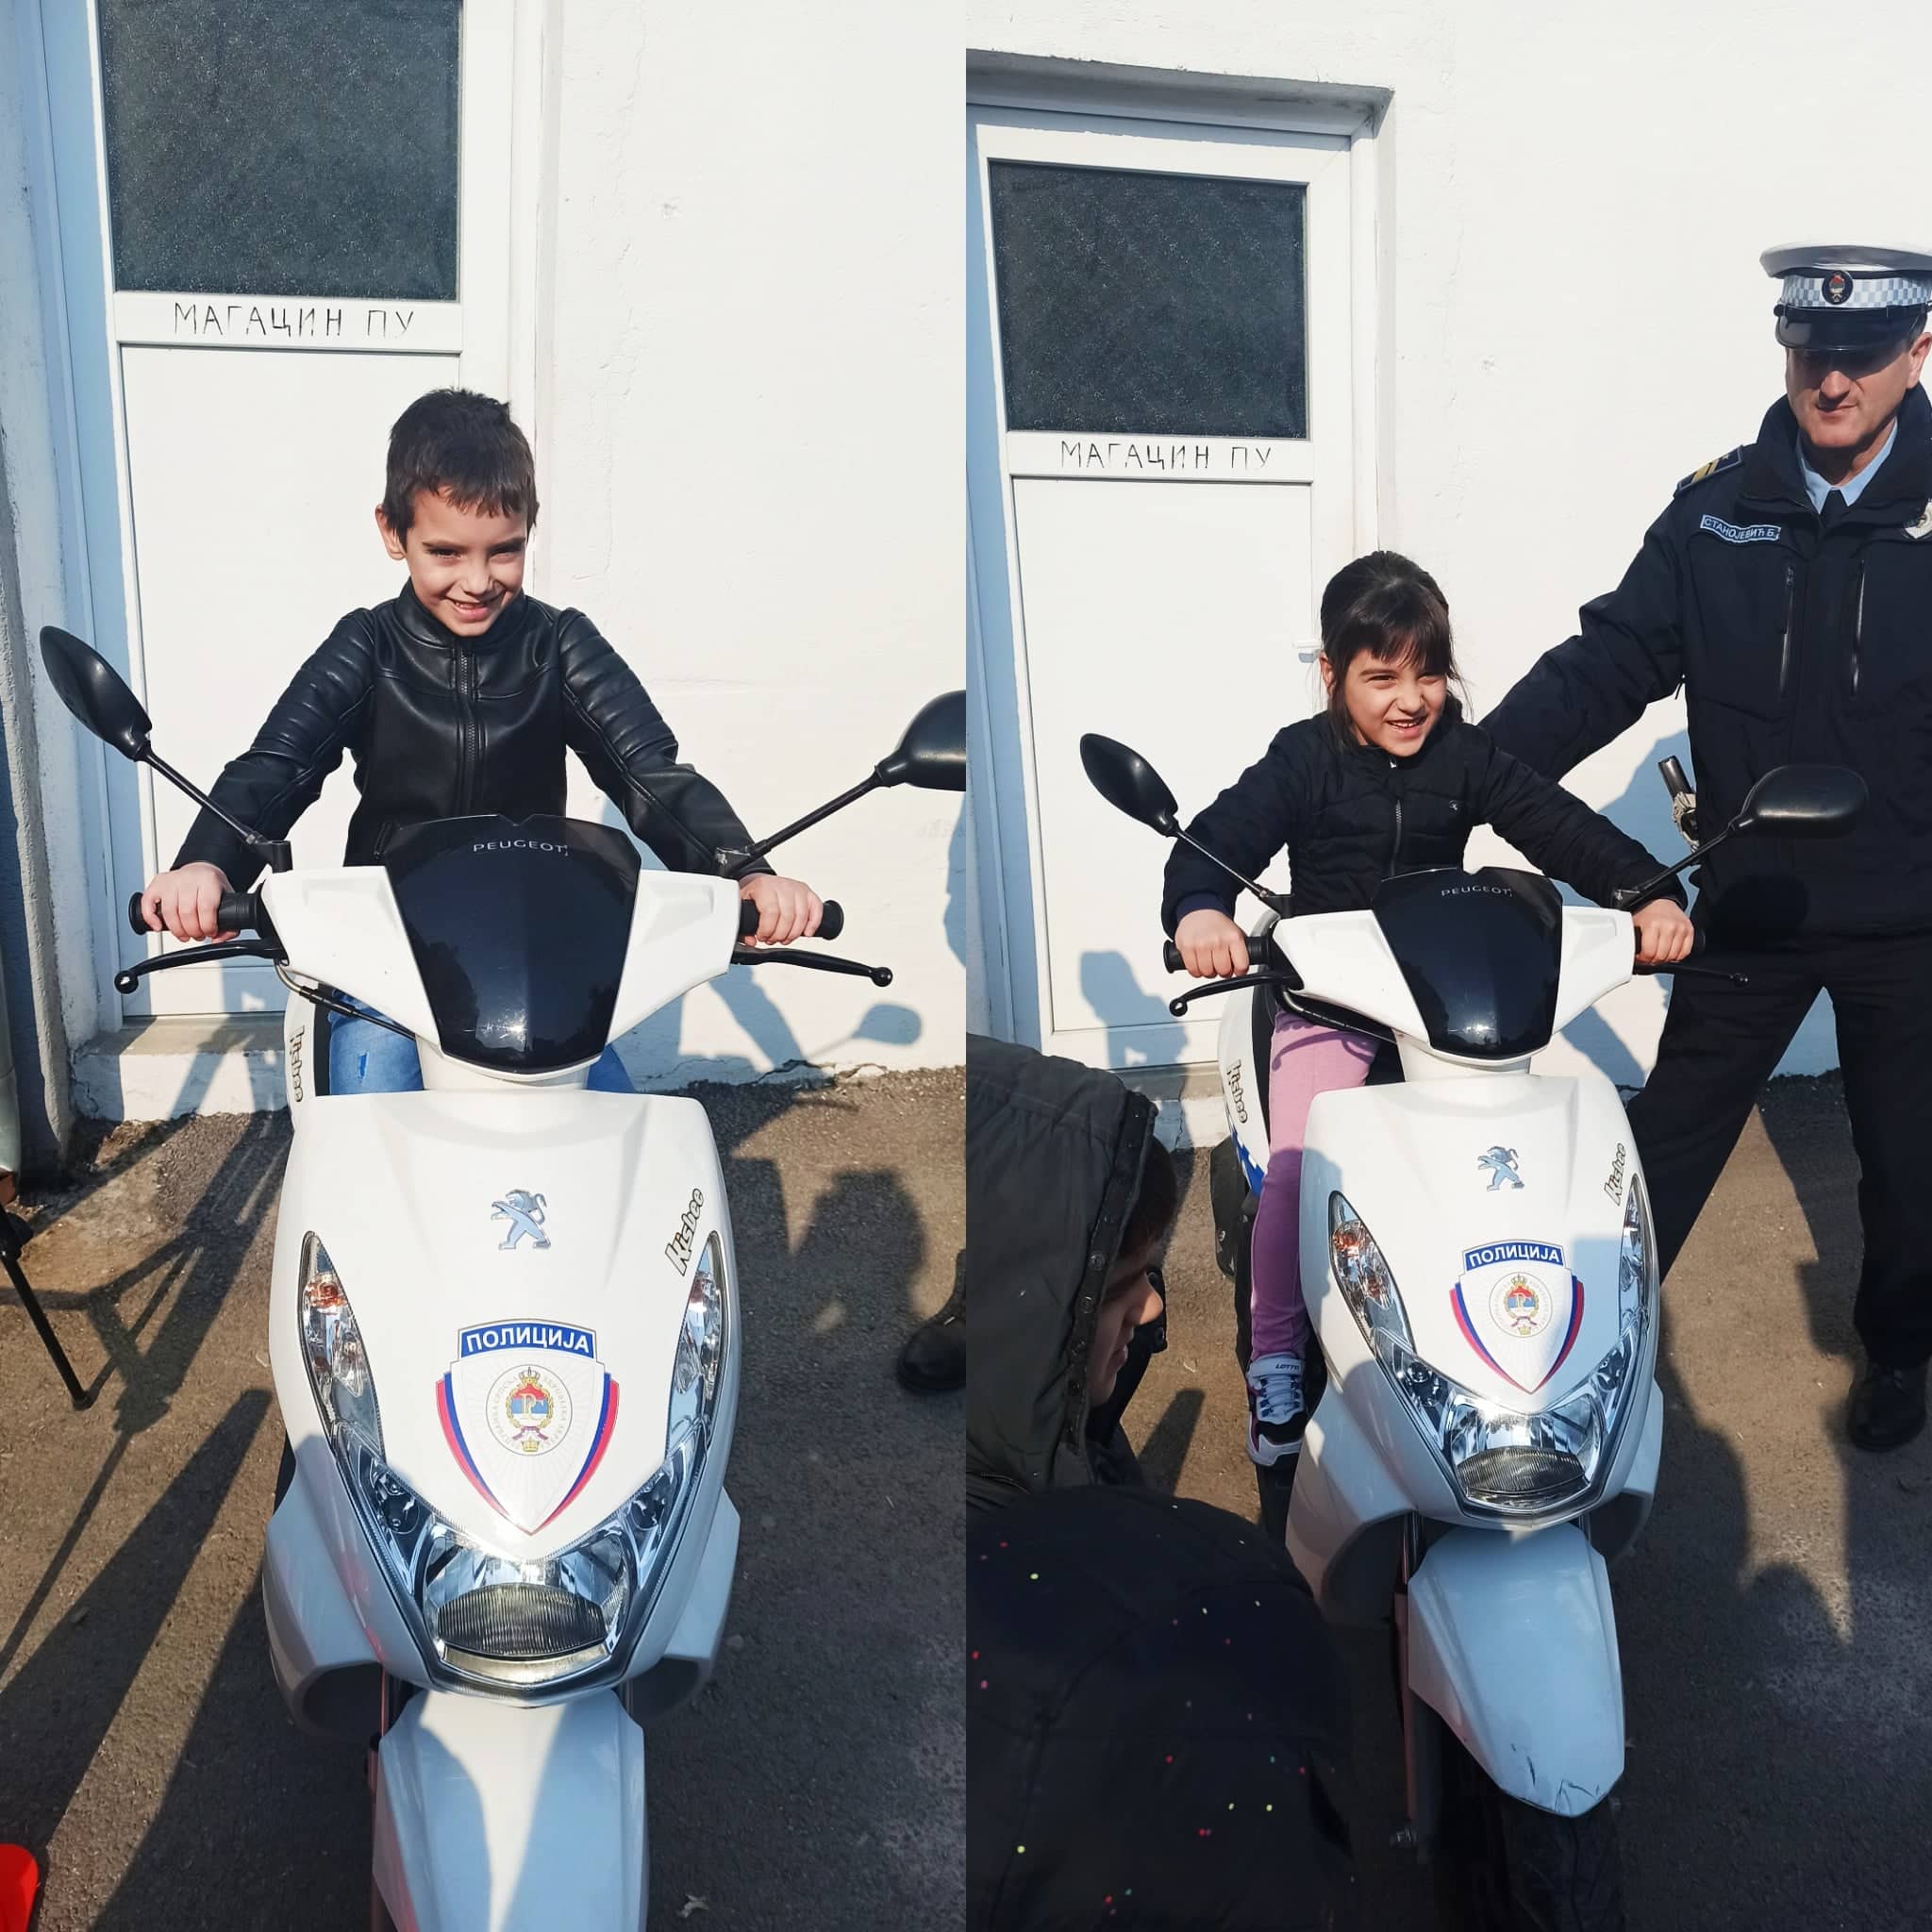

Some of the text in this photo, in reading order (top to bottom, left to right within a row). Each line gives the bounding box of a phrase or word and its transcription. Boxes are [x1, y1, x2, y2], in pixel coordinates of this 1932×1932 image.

[175, 301, 414, 338] МАГАЦИН ПУ
[1060, 440, 1272, 471] МАГАЦИН ПУ
[473, 839, 567, 854] PEUGEOT
[1441, 885, 1511, 897] PEUGEOT
[1604, 1141, 1626, 1207] Kisbee
[664, 1187, 705, 1277] Kisbee
[1469, 1244, 1560, 1268] ПОЛИЦИЈА
[465, 1326, 590, 1353] ПОЛИЦИЈА
